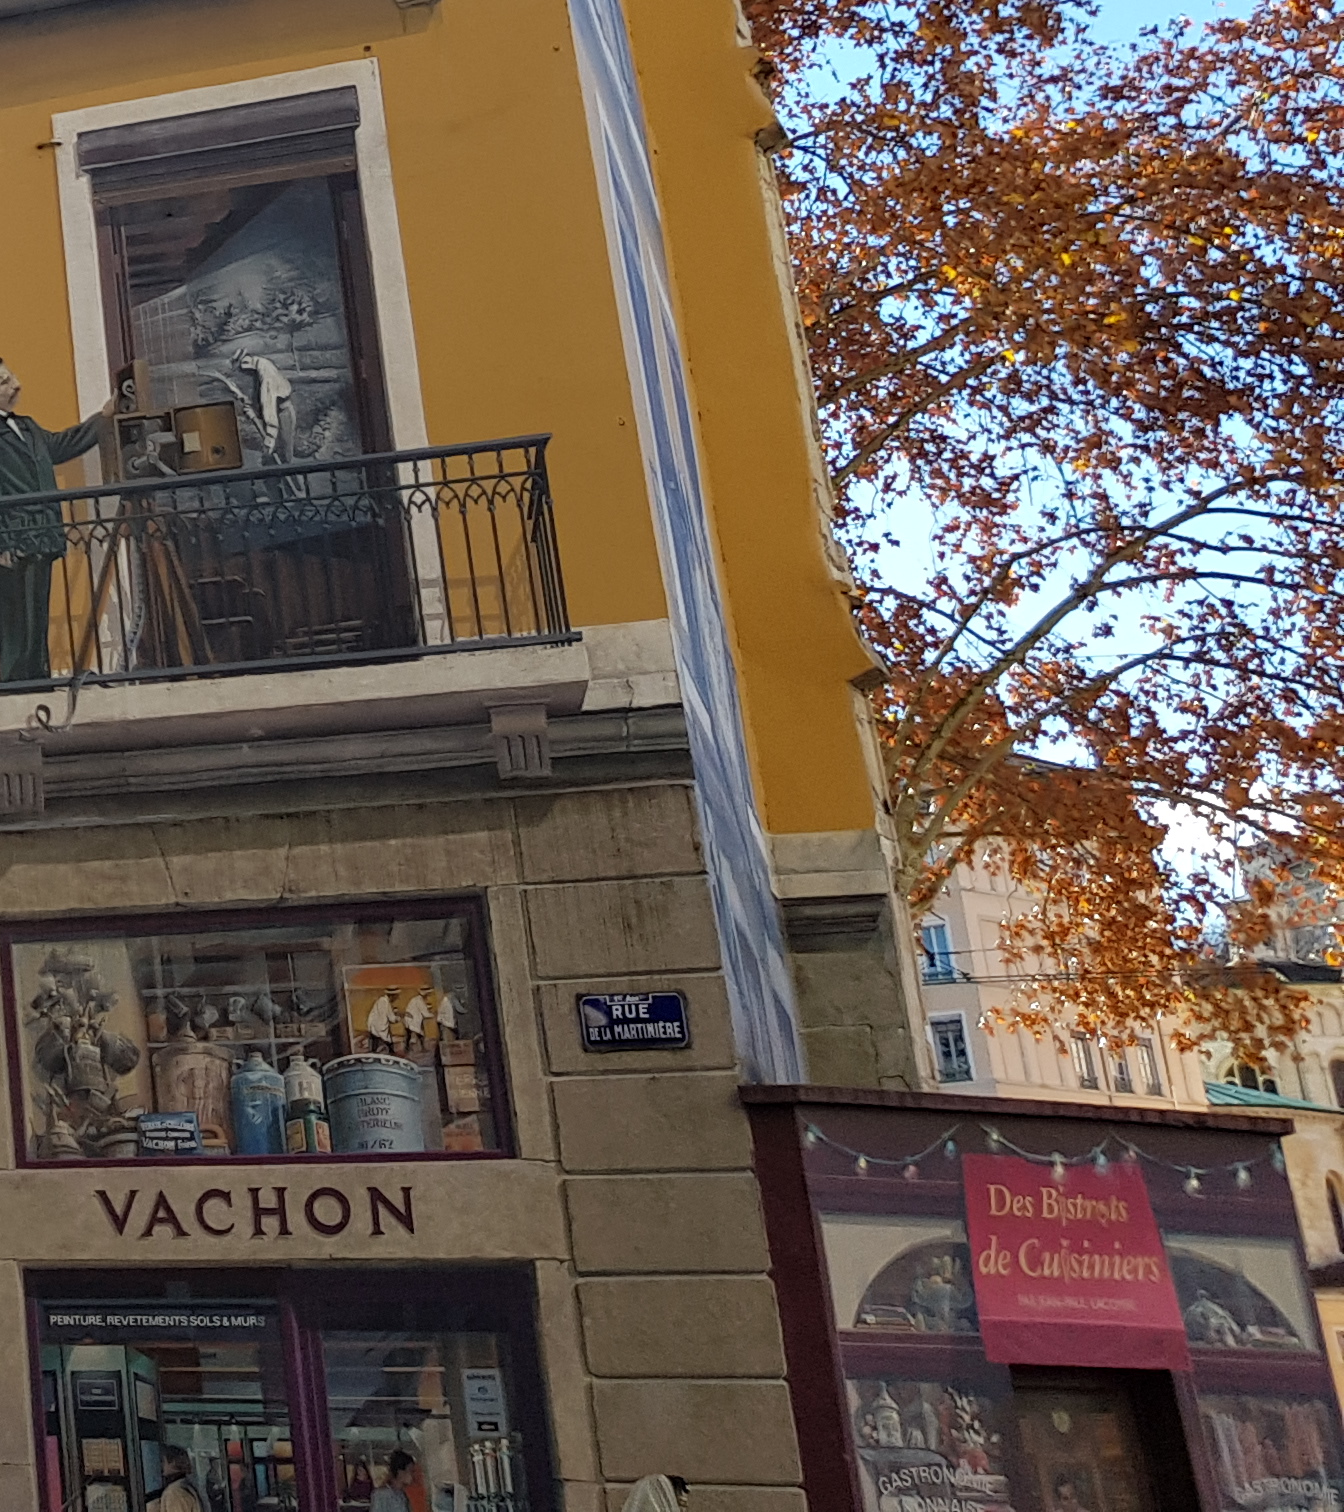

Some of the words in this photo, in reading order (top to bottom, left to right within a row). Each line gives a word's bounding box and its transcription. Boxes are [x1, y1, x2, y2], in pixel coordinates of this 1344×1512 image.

[612, 1003, 650, 1019] RUE
[589, 1028, 600, 1040] DE
[601, 1027, 612, 1040] LA
[614, 1021, 682, 1039] MARTINIÈRE
[94, 1187, 415, 1239] VACHON
[987, 1184, 1034, 1218] Des
[1040, 1185, 1129, 1224] Bistrots
[979, 1235, 1011, 1275] de
[1018, 1238, 1161, 1283] Cuisiniers
[49, 1315, 105, 1326] PEINTURE,
[107, 1315, 188, 1327] REVETEMENTS
[189, 1316, 220, 1327] SOLS
[222, 1316, 229, 1326] &
[231, 1316, 265, 1327] MURS
